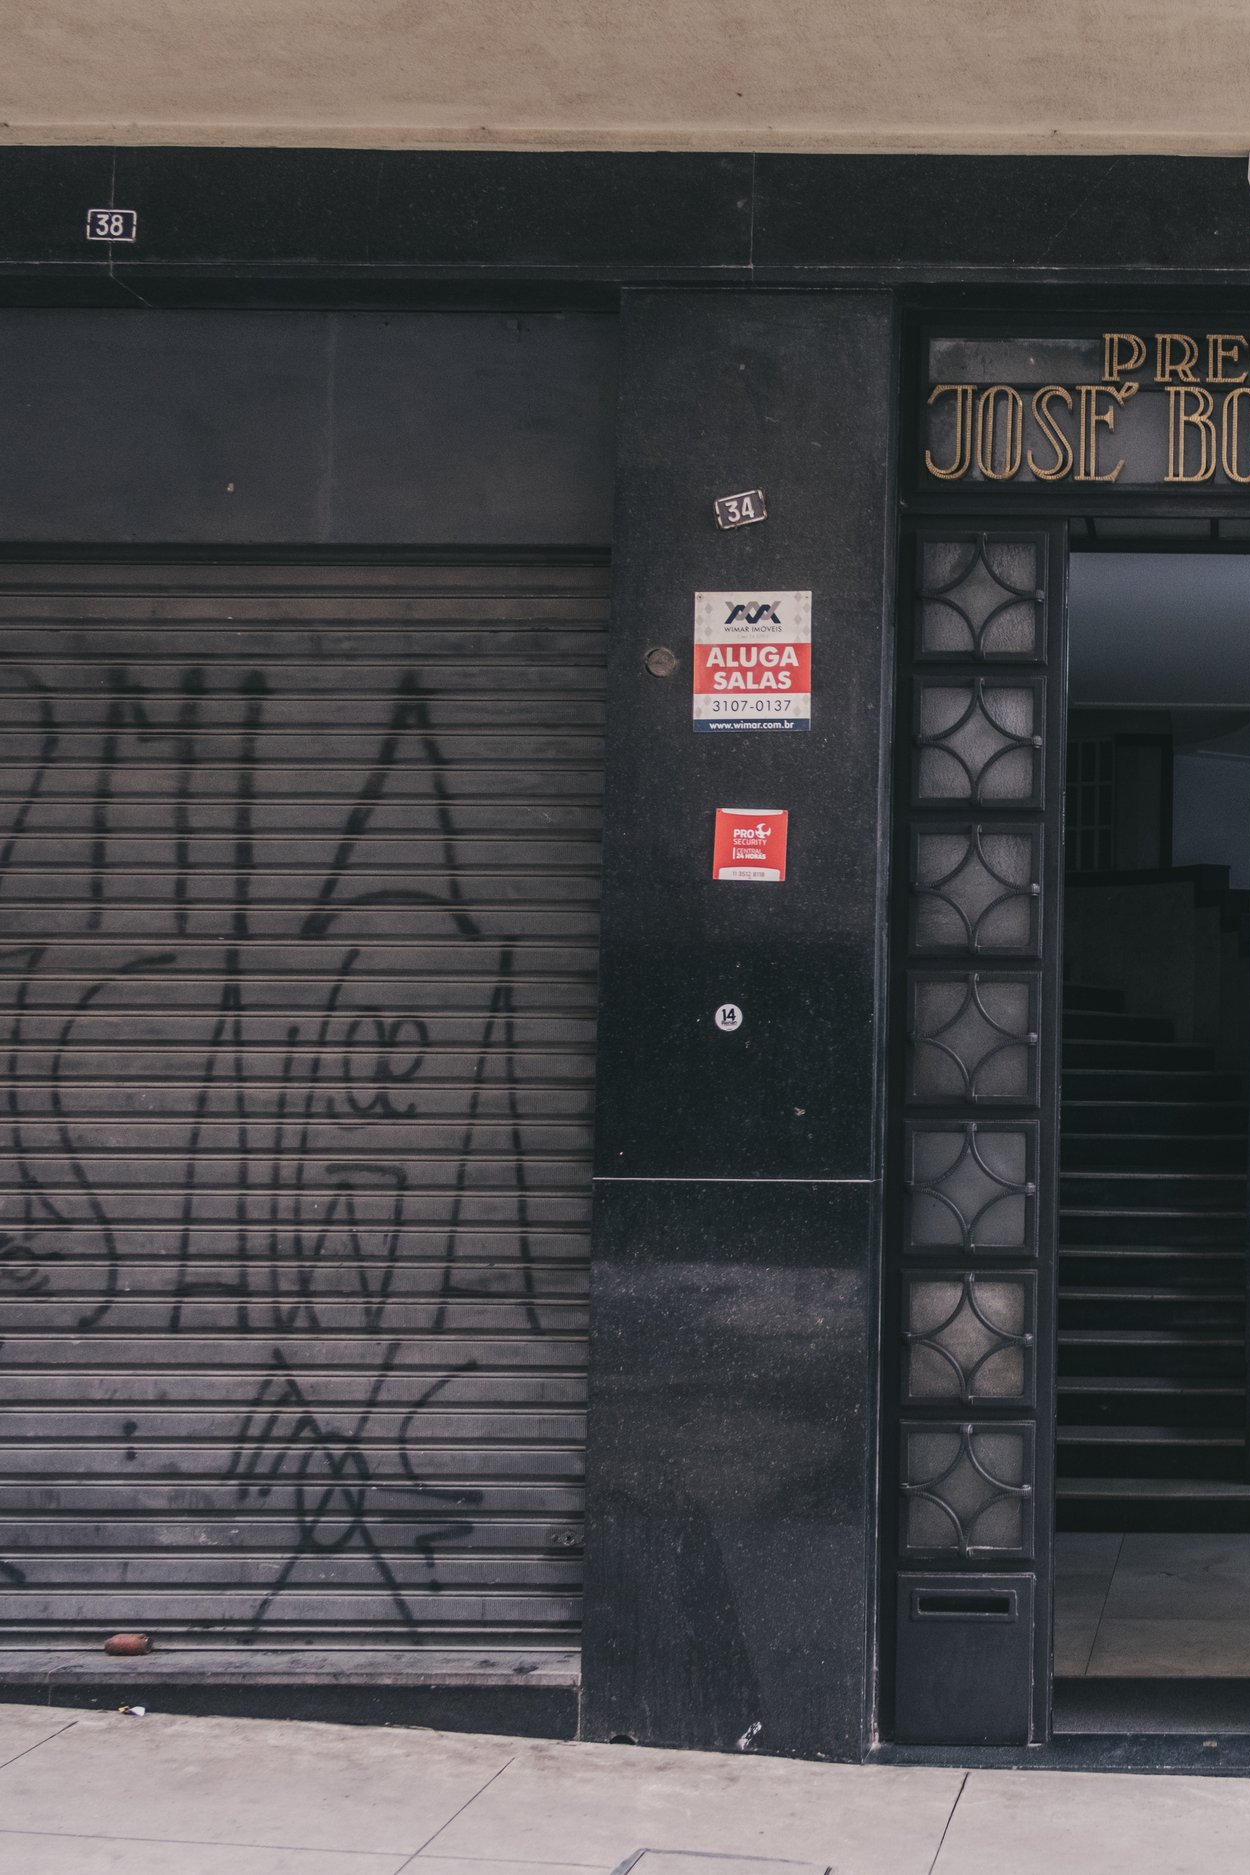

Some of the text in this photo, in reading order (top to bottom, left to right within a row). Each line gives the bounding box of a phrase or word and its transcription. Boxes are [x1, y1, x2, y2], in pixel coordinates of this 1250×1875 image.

[95, 213, 124, 236] 38
[924, 381, 1141, 484] JOSÉ
[725, 496, 755, 523] 34
[706, 646, 799, 668] ALUGA
[713, 671, 792, 690] SALAS
[712, 699, 792, 712] 3107-0137
[709, 720, 794, 730] www.wimar.com.br
[733, 829, 755, 838] PRO
[733, 838, 767, 846] SECURITY
[722, 1008, 736, 1021] 14
